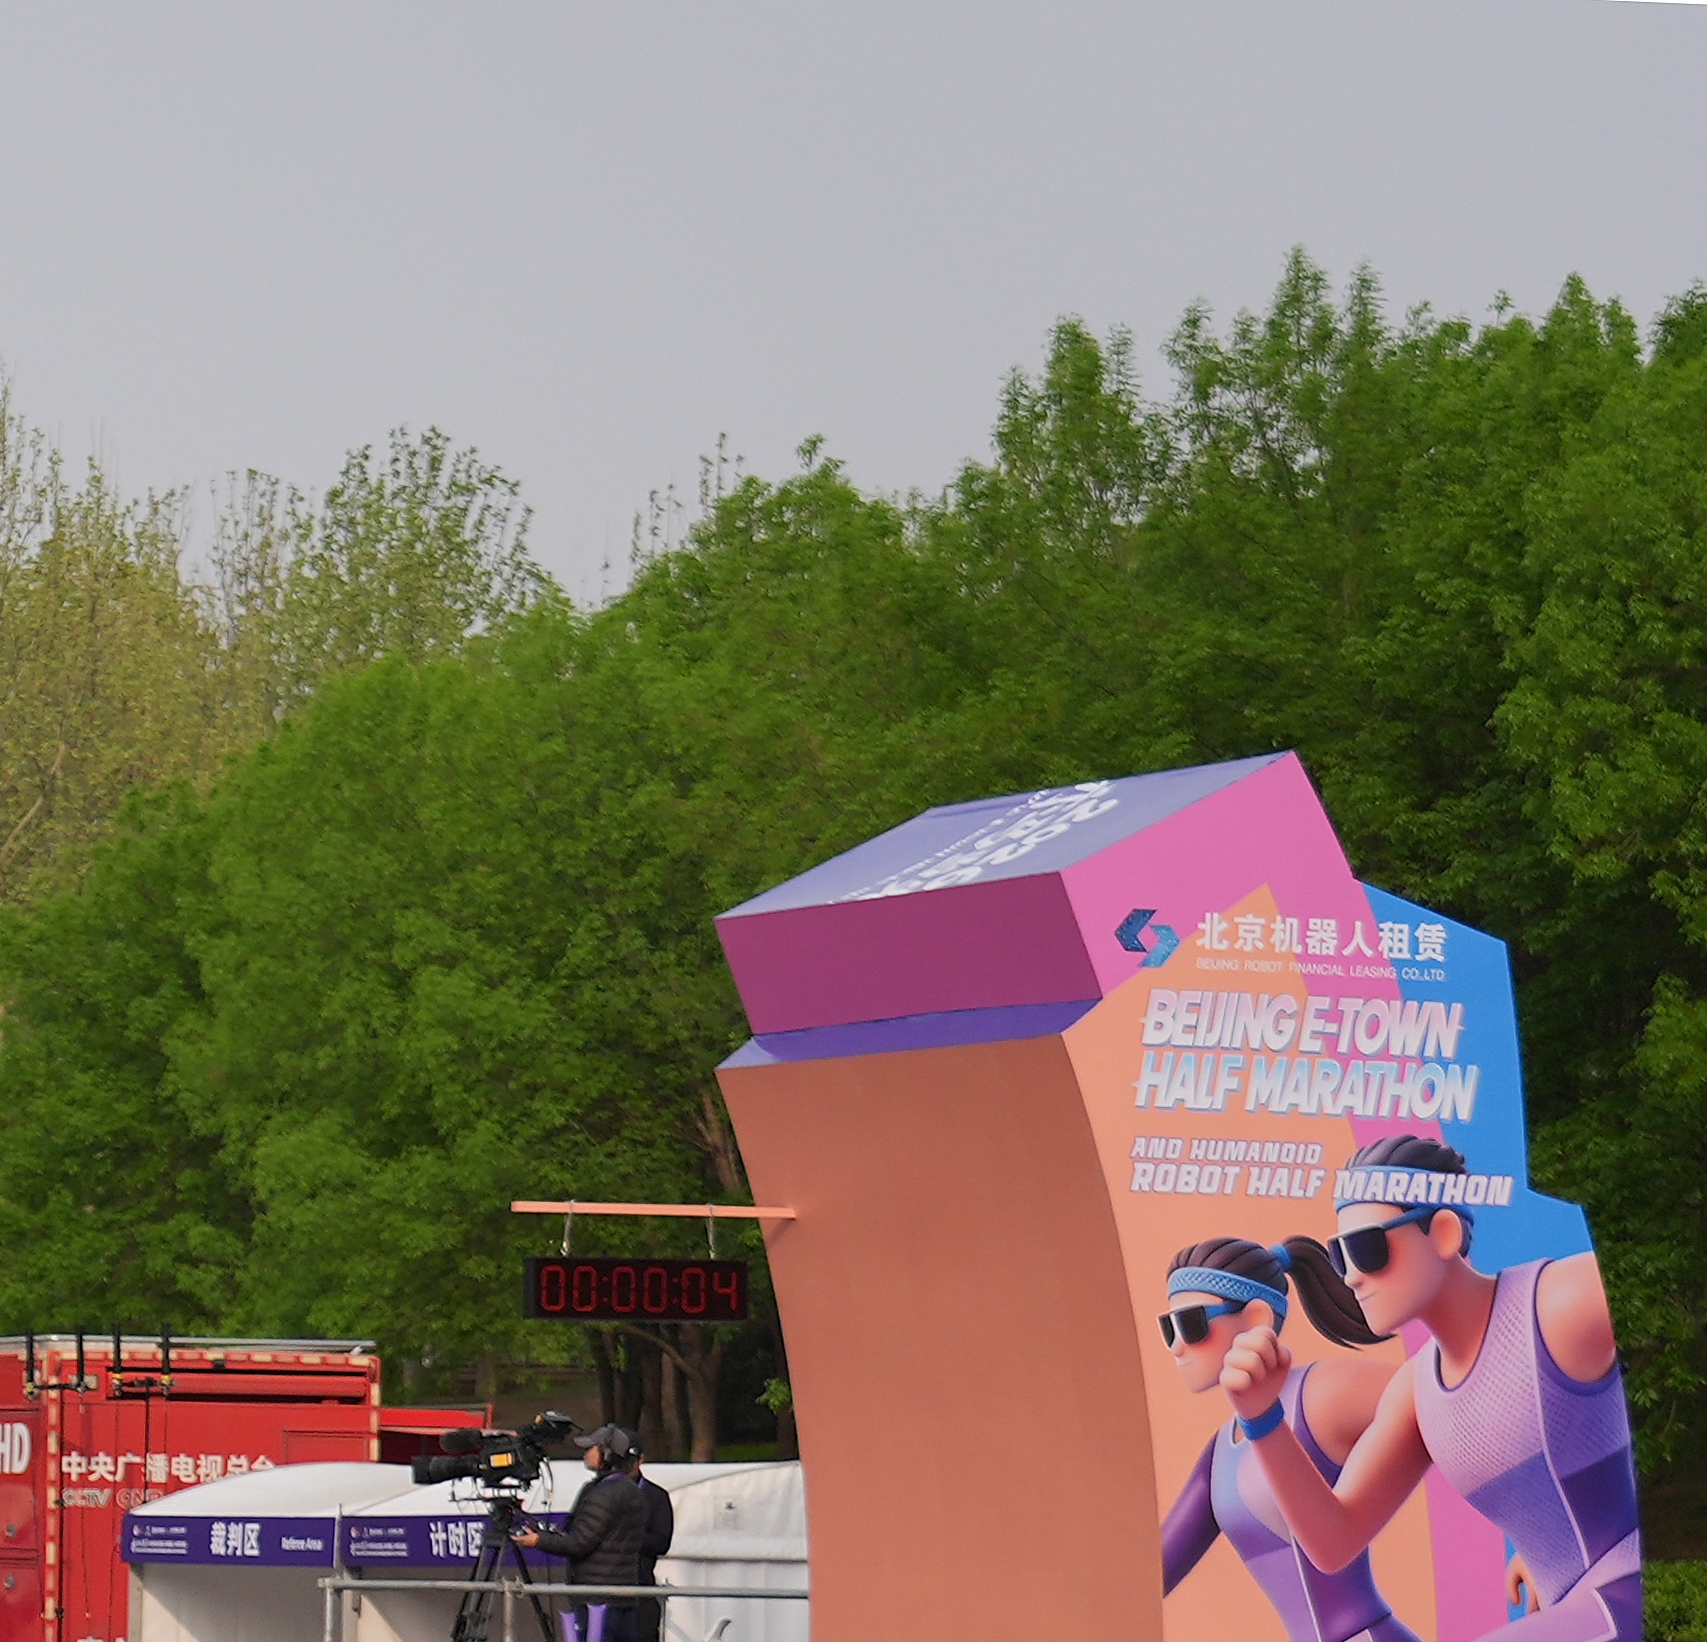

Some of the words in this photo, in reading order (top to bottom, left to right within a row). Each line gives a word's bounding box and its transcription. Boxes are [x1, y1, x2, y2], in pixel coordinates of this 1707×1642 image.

[1196, 911, 1448, 963] 北京机器人租赁
[1196, 957, 1239, 971] BEIJING
[1244, 960, 1284, 974] ROBOT
[1289, 961, 1345, 976] FINANCIAL
[1349, 965, 1398, 979] LEASING
[1142, 987, 1298, 1052] BEIJING
[1299, 993, 1465, 1060] E-TOWN
[1134, 1051, 1246, 1111] HALF
[1245, 1054, 1480, 1123] MARATHON
[1131, 1136, 1183, 1160] AND
[1189, 1138, 1325, 1165] HUMANOID
[1131, 1162, 1241, 1195] ROBOT
[1248, 1166, 1326, 1198] HALF
[1332, 1170, 1515, 1206] MARATHON
[540, 1265, 739, 1314] 00:00:04
[210, 1521, 262, 1558] 裁判区
[428, 1521, 484, 1558] 计时区
